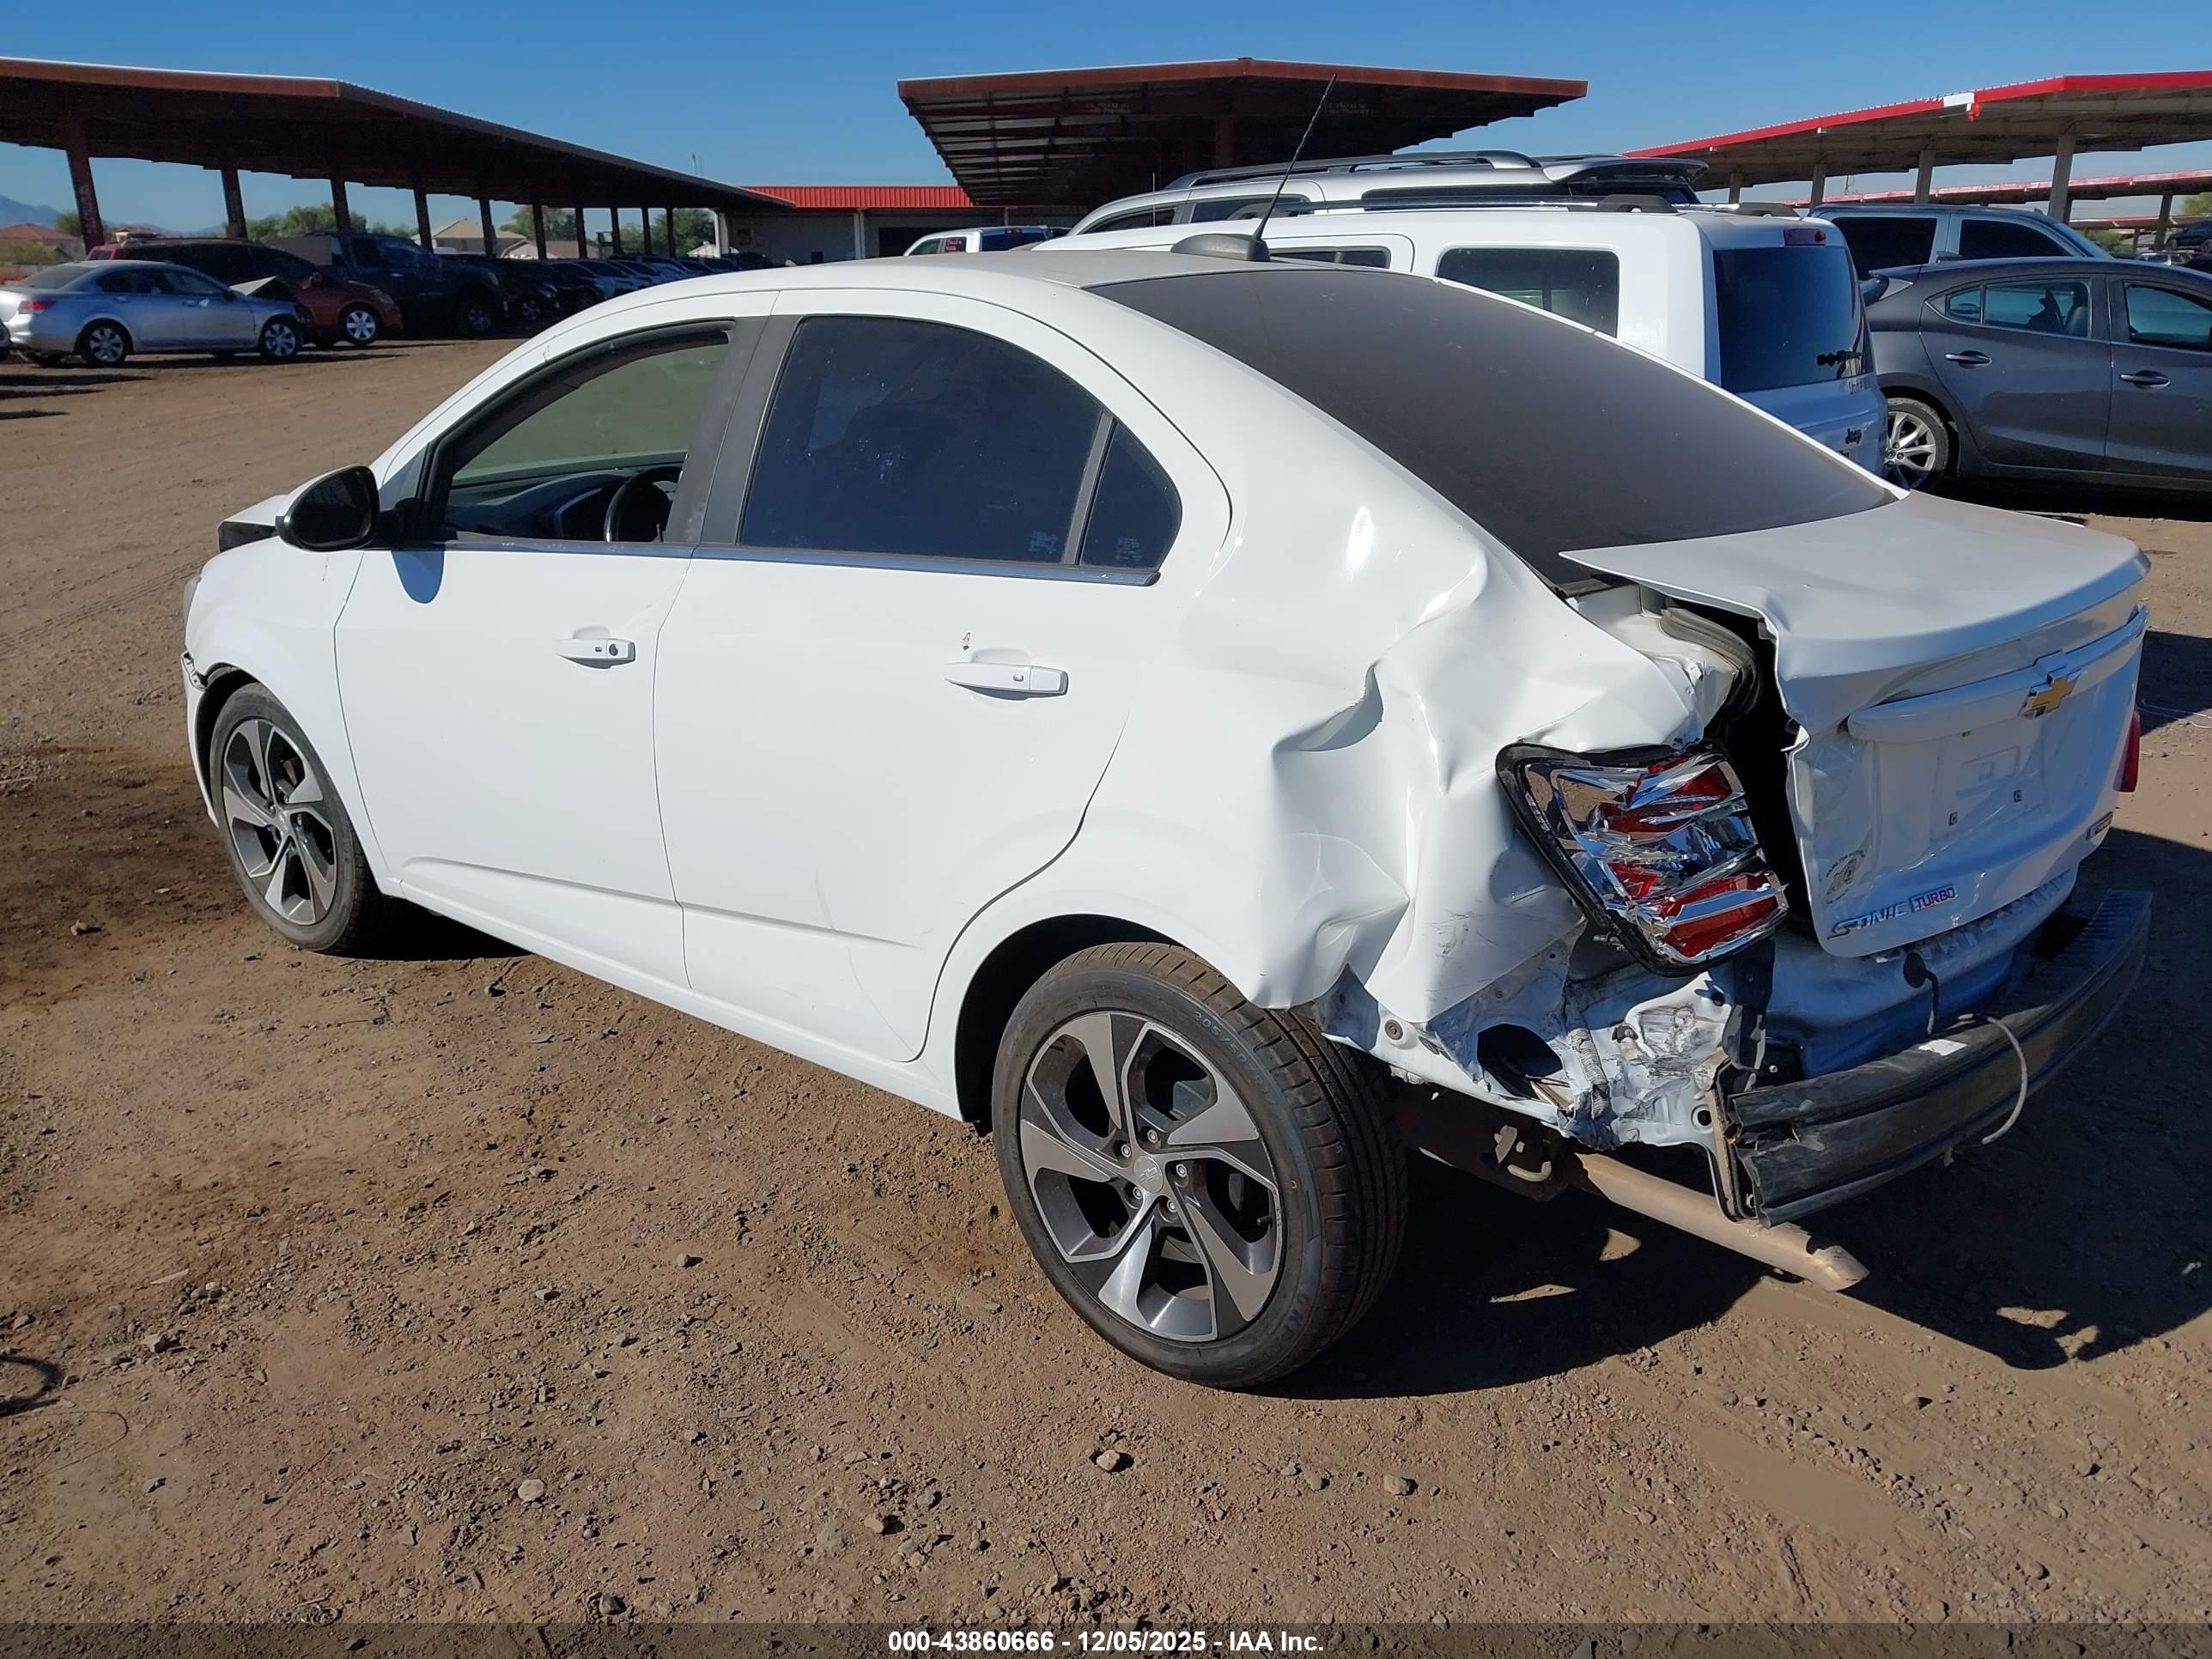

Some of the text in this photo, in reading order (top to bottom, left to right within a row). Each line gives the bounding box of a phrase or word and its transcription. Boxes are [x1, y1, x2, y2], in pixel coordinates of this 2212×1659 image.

[1845, 428, 1863, 445] Jeep
[1826, 886, 1957, 941] SONIC TURBO
